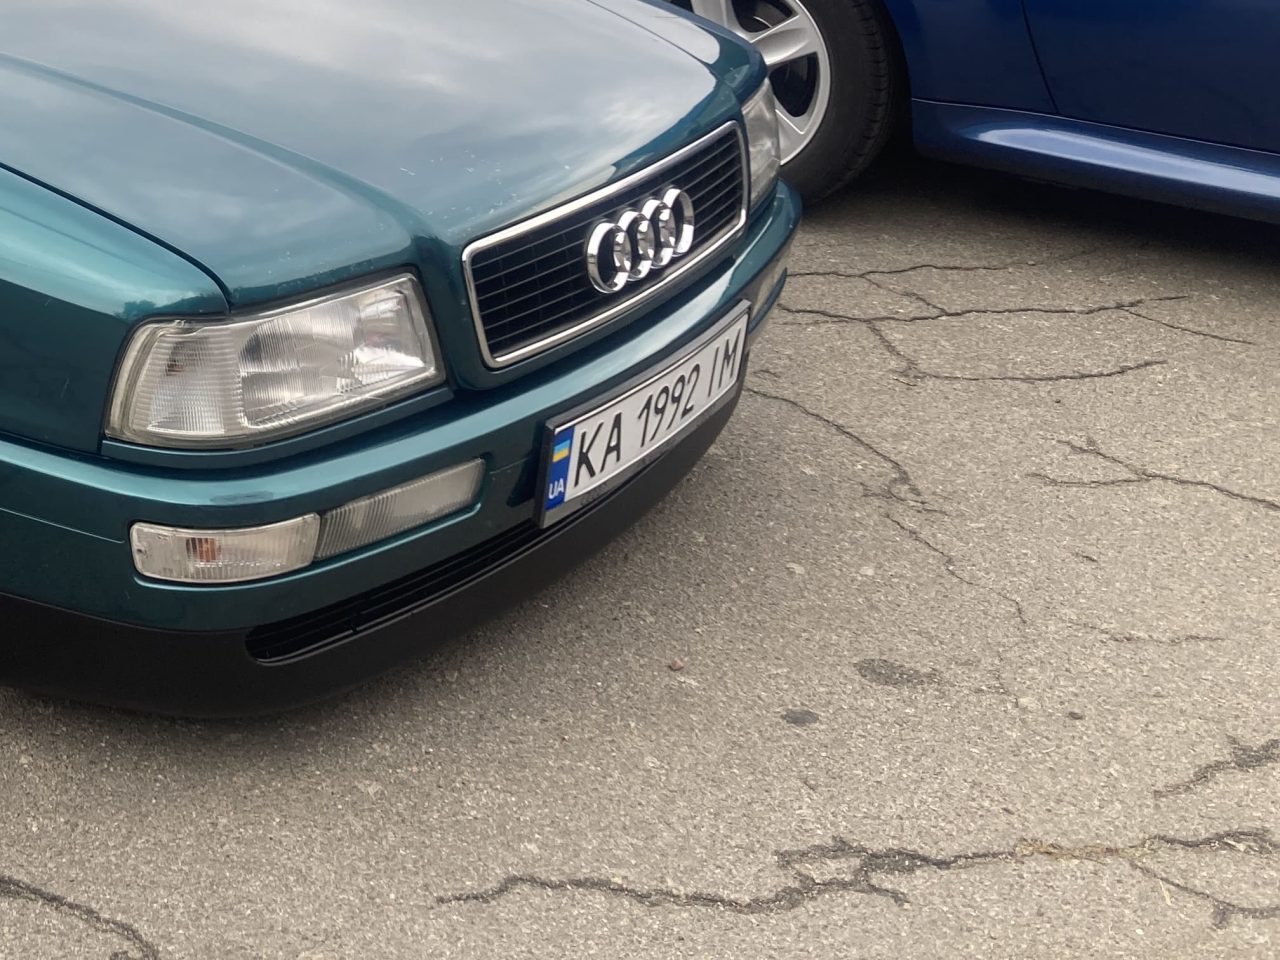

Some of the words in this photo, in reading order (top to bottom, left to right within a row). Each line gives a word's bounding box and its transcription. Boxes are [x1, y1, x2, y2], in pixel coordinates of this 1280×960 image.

[573, 412, 622, 487] KA
[638, 364, 699, 447] 1992
[708, 328, 743, 399] IM
[548, 478, 565, 499] UA
